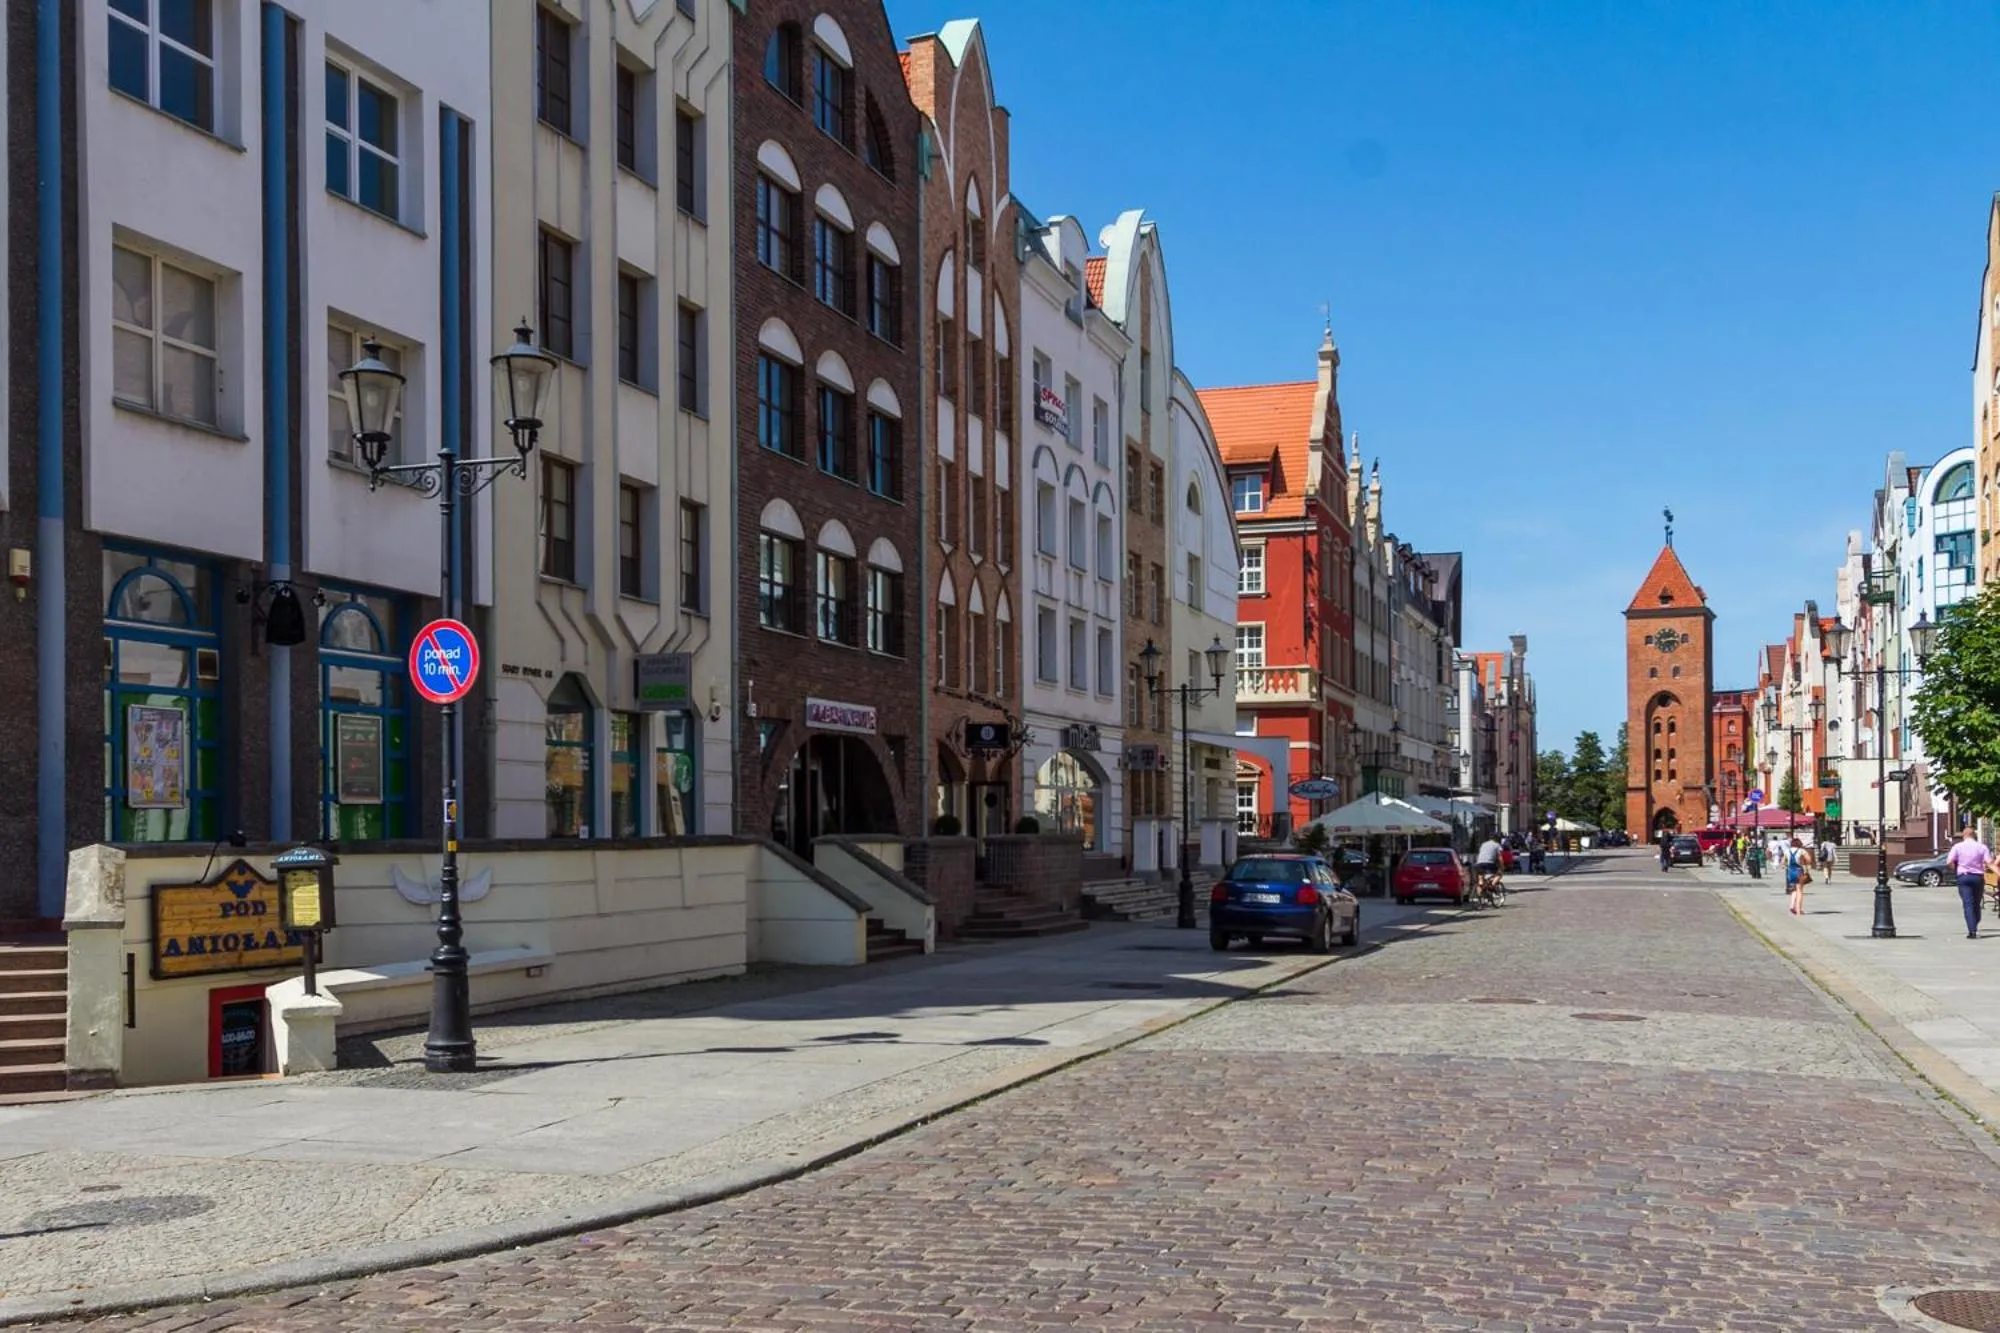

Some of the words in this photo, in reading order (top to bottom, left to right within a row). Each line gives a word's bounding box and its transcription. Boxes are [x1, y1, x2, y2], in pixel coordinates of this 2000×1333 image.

[424, 647, 460, 661] ponad
[424, 662, 436, 675] 10
[220, 901, 266, 917] POD
